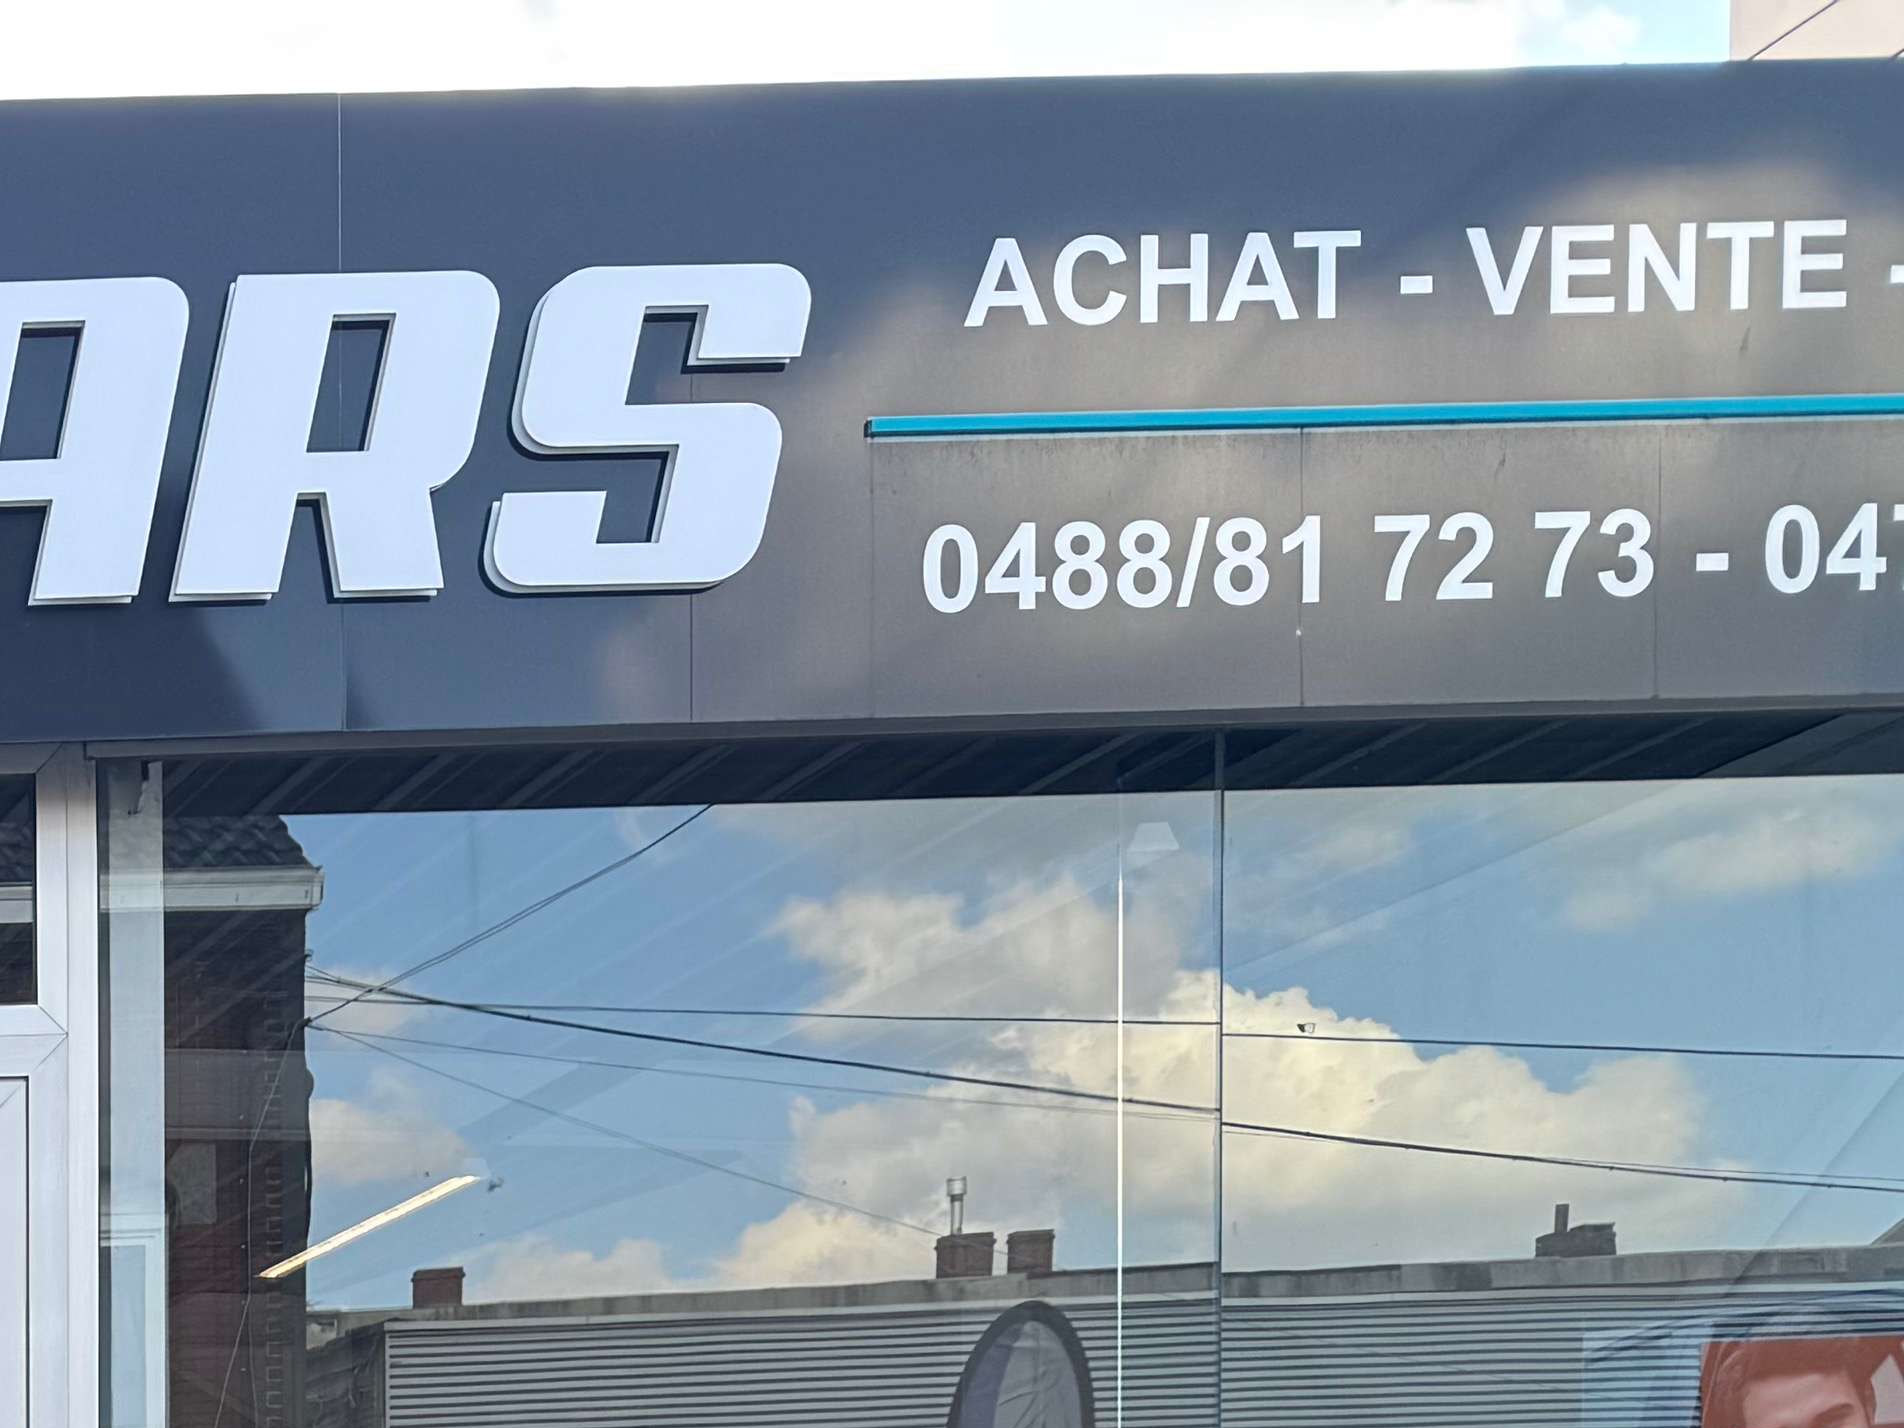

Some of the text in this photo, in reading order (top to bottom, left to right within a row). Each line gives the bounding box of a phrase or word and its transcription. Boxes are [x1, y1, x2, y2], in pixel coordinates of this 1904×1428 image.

[963, 230, 1362, 327] ACHAT
[1400, 275, 1433, 295] -
[1466, 219, 1848, 316] VENTE
[923, 503, 1904, 614] 0488/81 72 73 - 04
